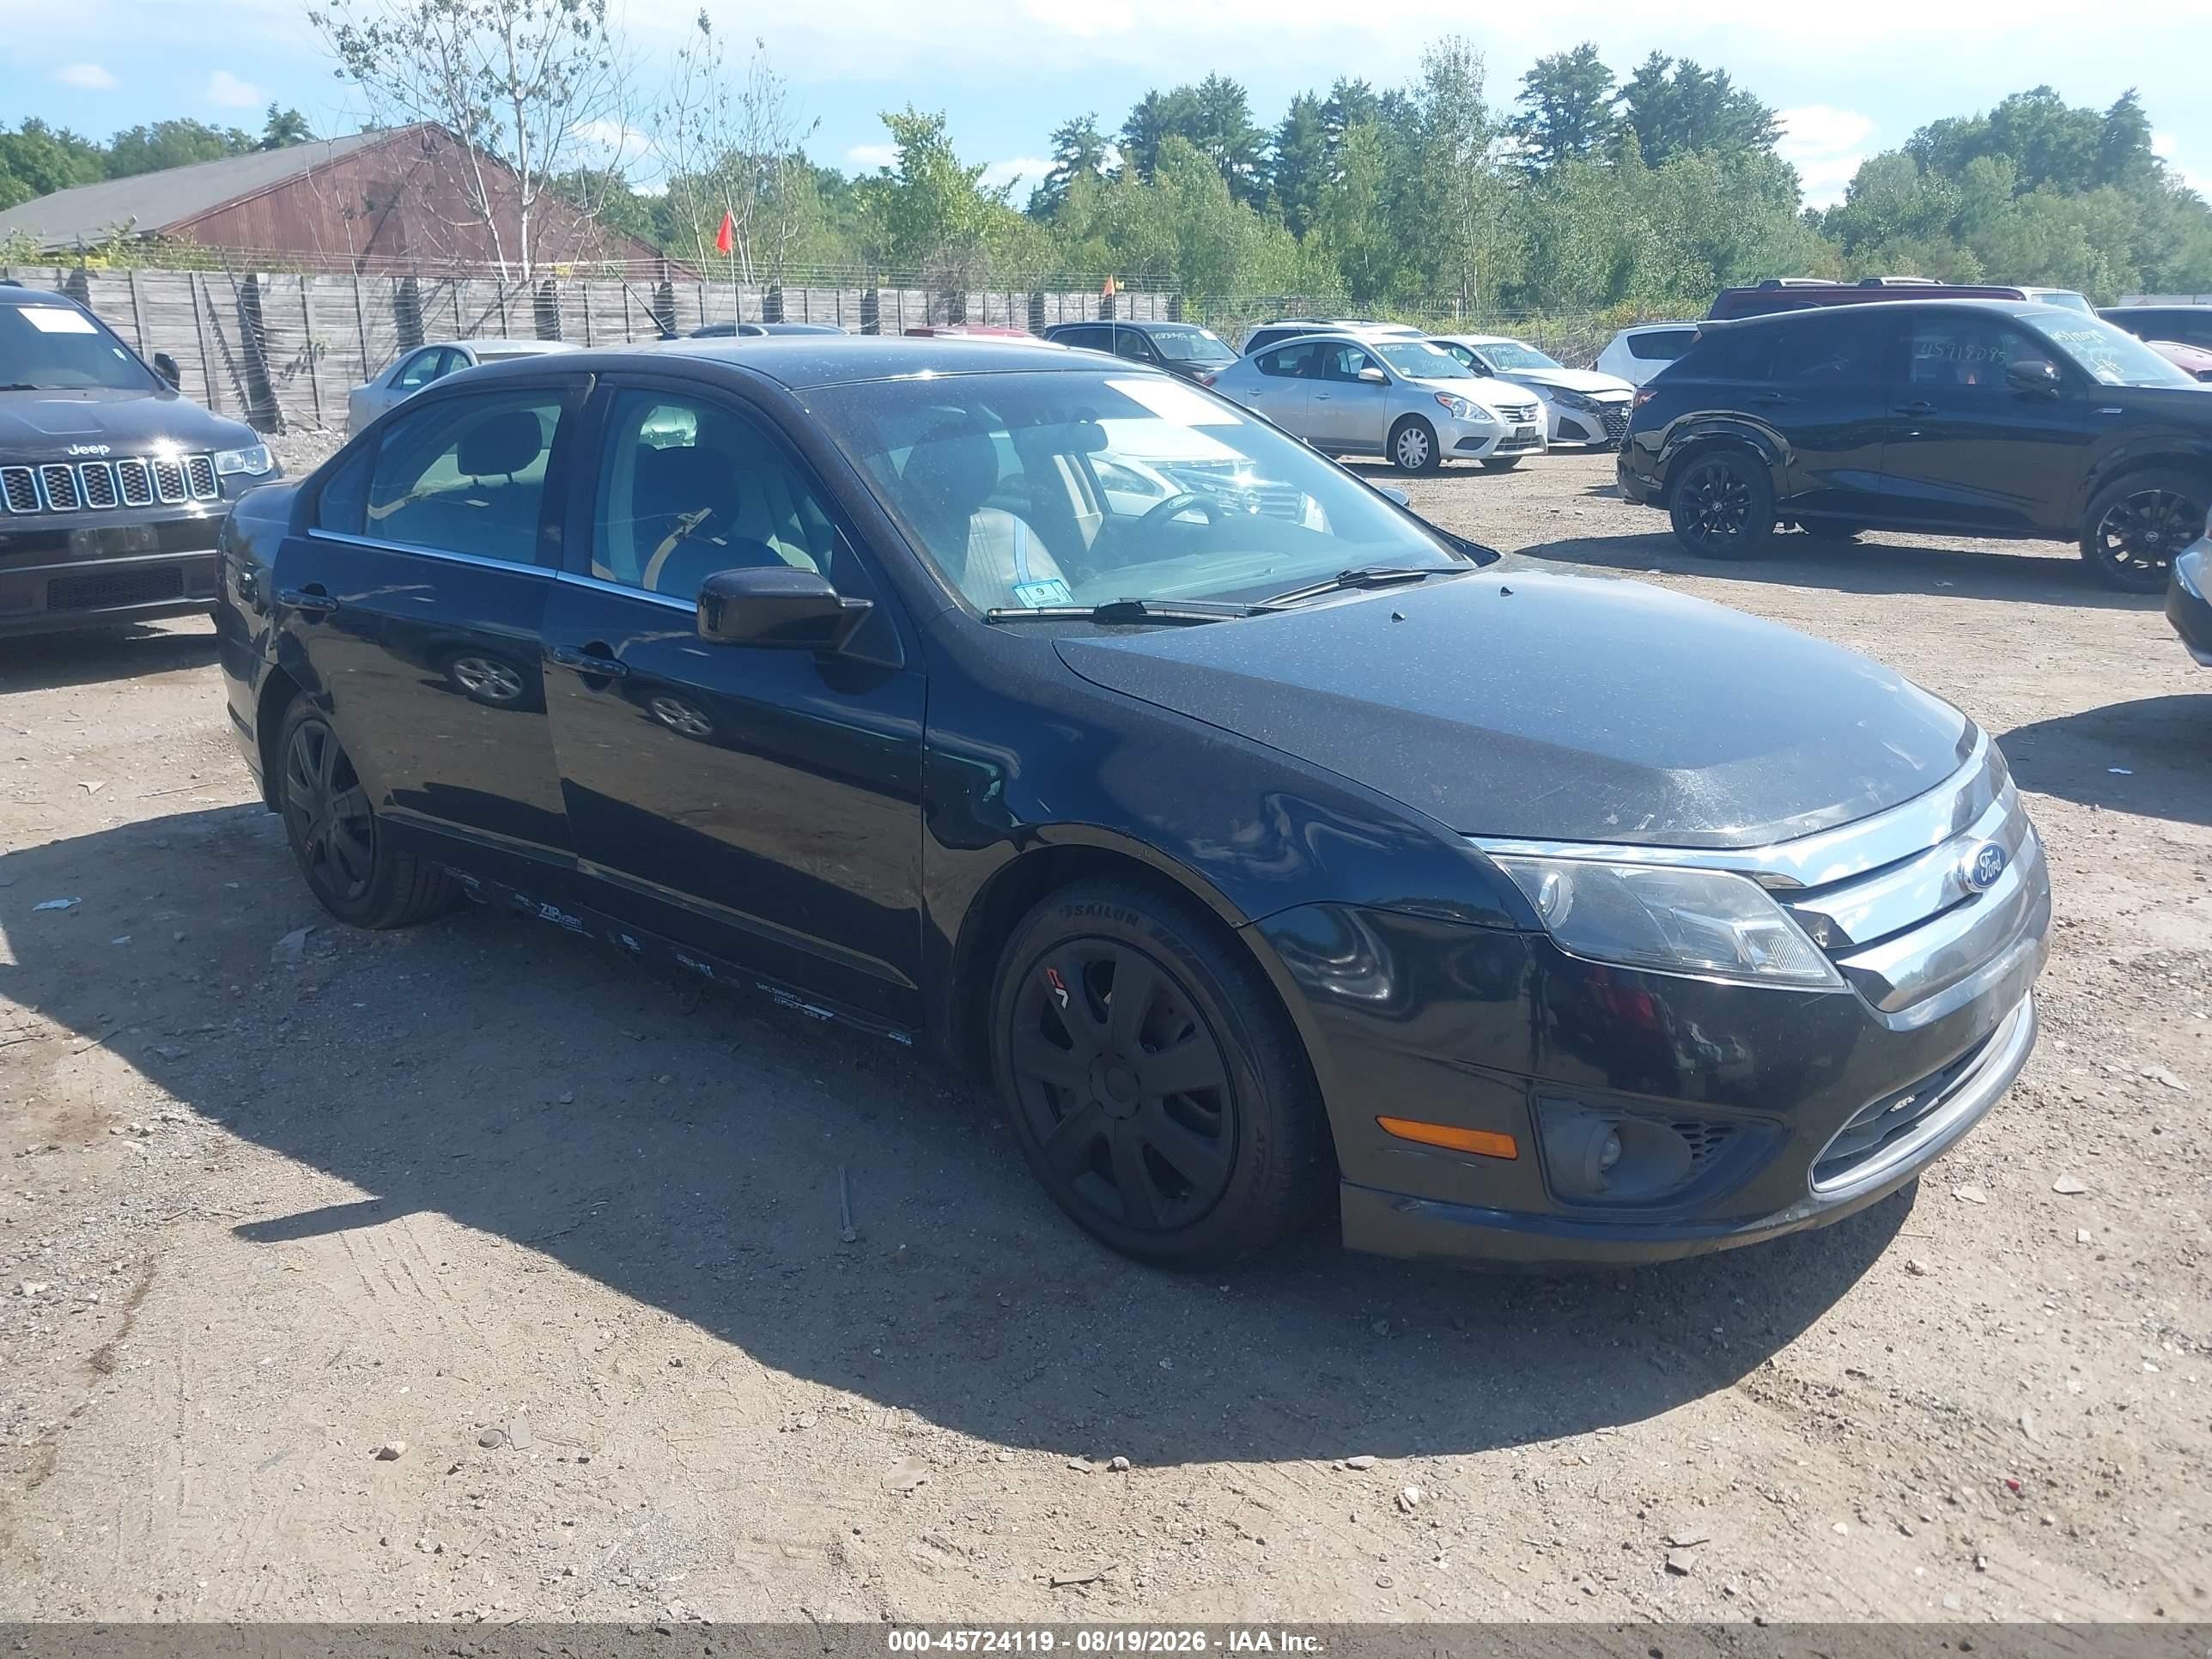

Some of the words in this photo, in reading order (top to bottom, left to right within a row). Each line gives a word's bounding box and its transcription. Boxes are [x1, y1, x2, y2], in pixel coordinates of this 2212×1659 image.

[67, 444, 111, 456] Jeep
[1979, 849, 2002, 883] Ford
[1073, 904, 1139, 927] SAILUN
